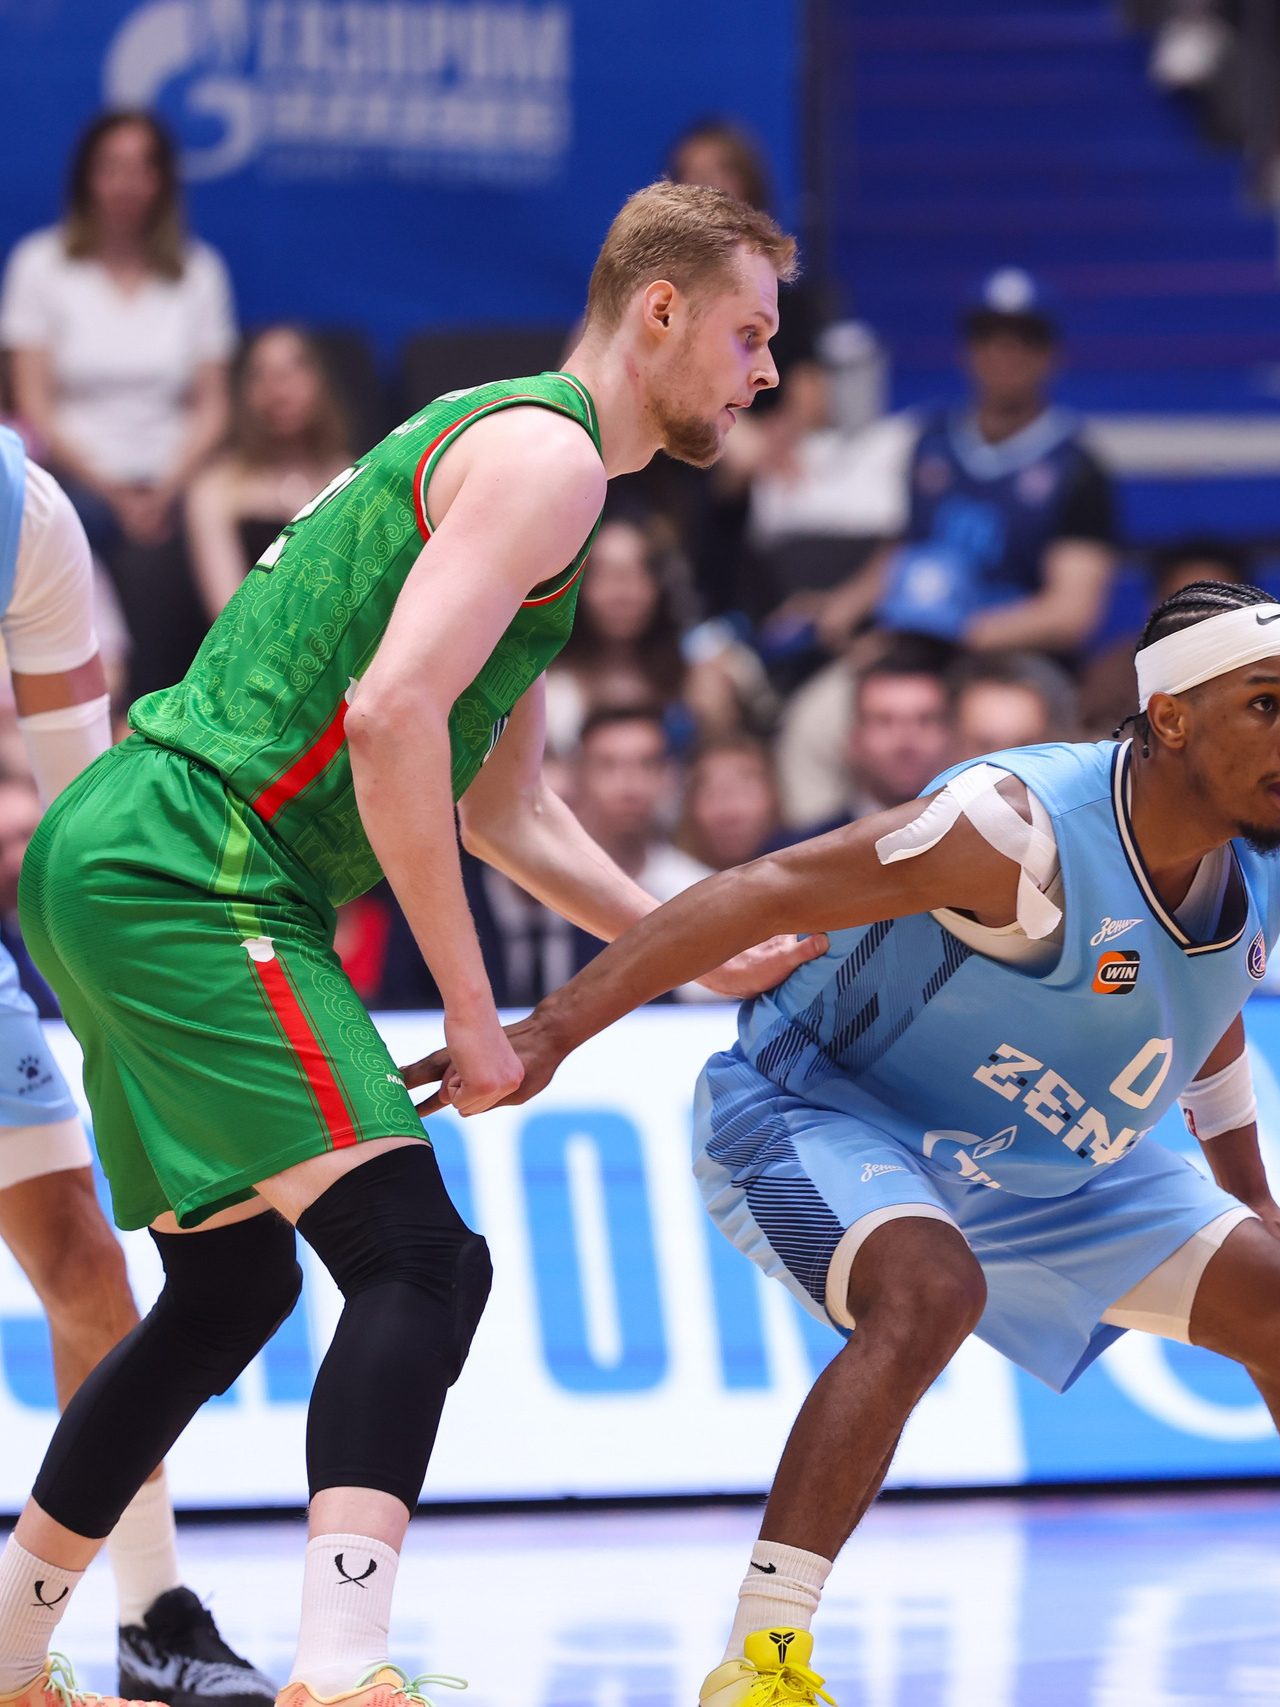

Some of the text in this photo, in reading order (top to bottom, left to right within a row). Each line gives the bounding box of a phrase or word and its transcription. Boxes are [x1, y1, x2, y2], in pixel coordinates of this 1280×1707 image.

[1105, 966, 1138, 980] WIN
[972, 1043, 1155, 1167] ZEN
[1108, 1037, 1174, 1110] 0
